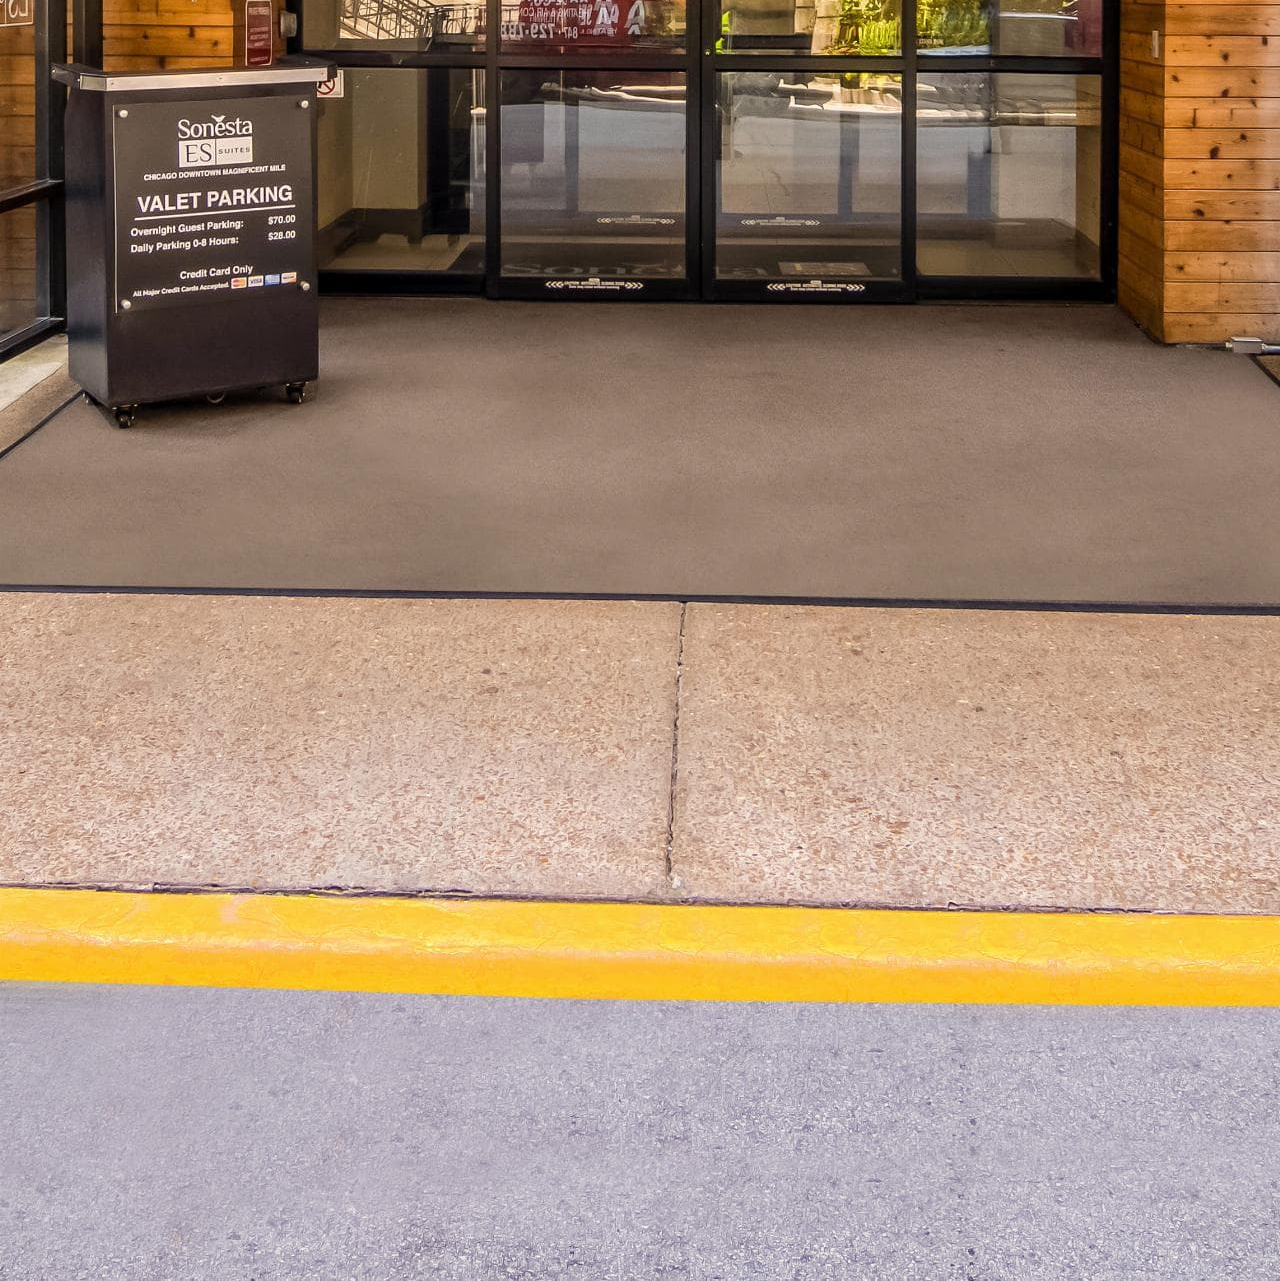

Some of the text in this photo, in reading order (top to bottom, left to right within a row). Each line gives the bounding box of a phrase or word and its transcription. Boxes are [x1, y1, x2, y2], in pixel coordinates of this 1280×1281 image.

[177, 118, 253, 139] Sonesta
[185, 143, 251, 163] ES SUITES
[143, 163, 286, 182] CHICAGO DOWNTOWN MAGNIFICENT MILE
[137, 184, 293, 213] VALET PARKING
[130, 214, 296, 237] Overnight Guest Parking: $70.00
[130, 230, 296, 254] Daily Parking 0-8 Hours: $28.00
[179, 264, 254, 280] Credit Card Only
[142, 288, 160, 297] Major
[181, 285, 199, 293] Cards
